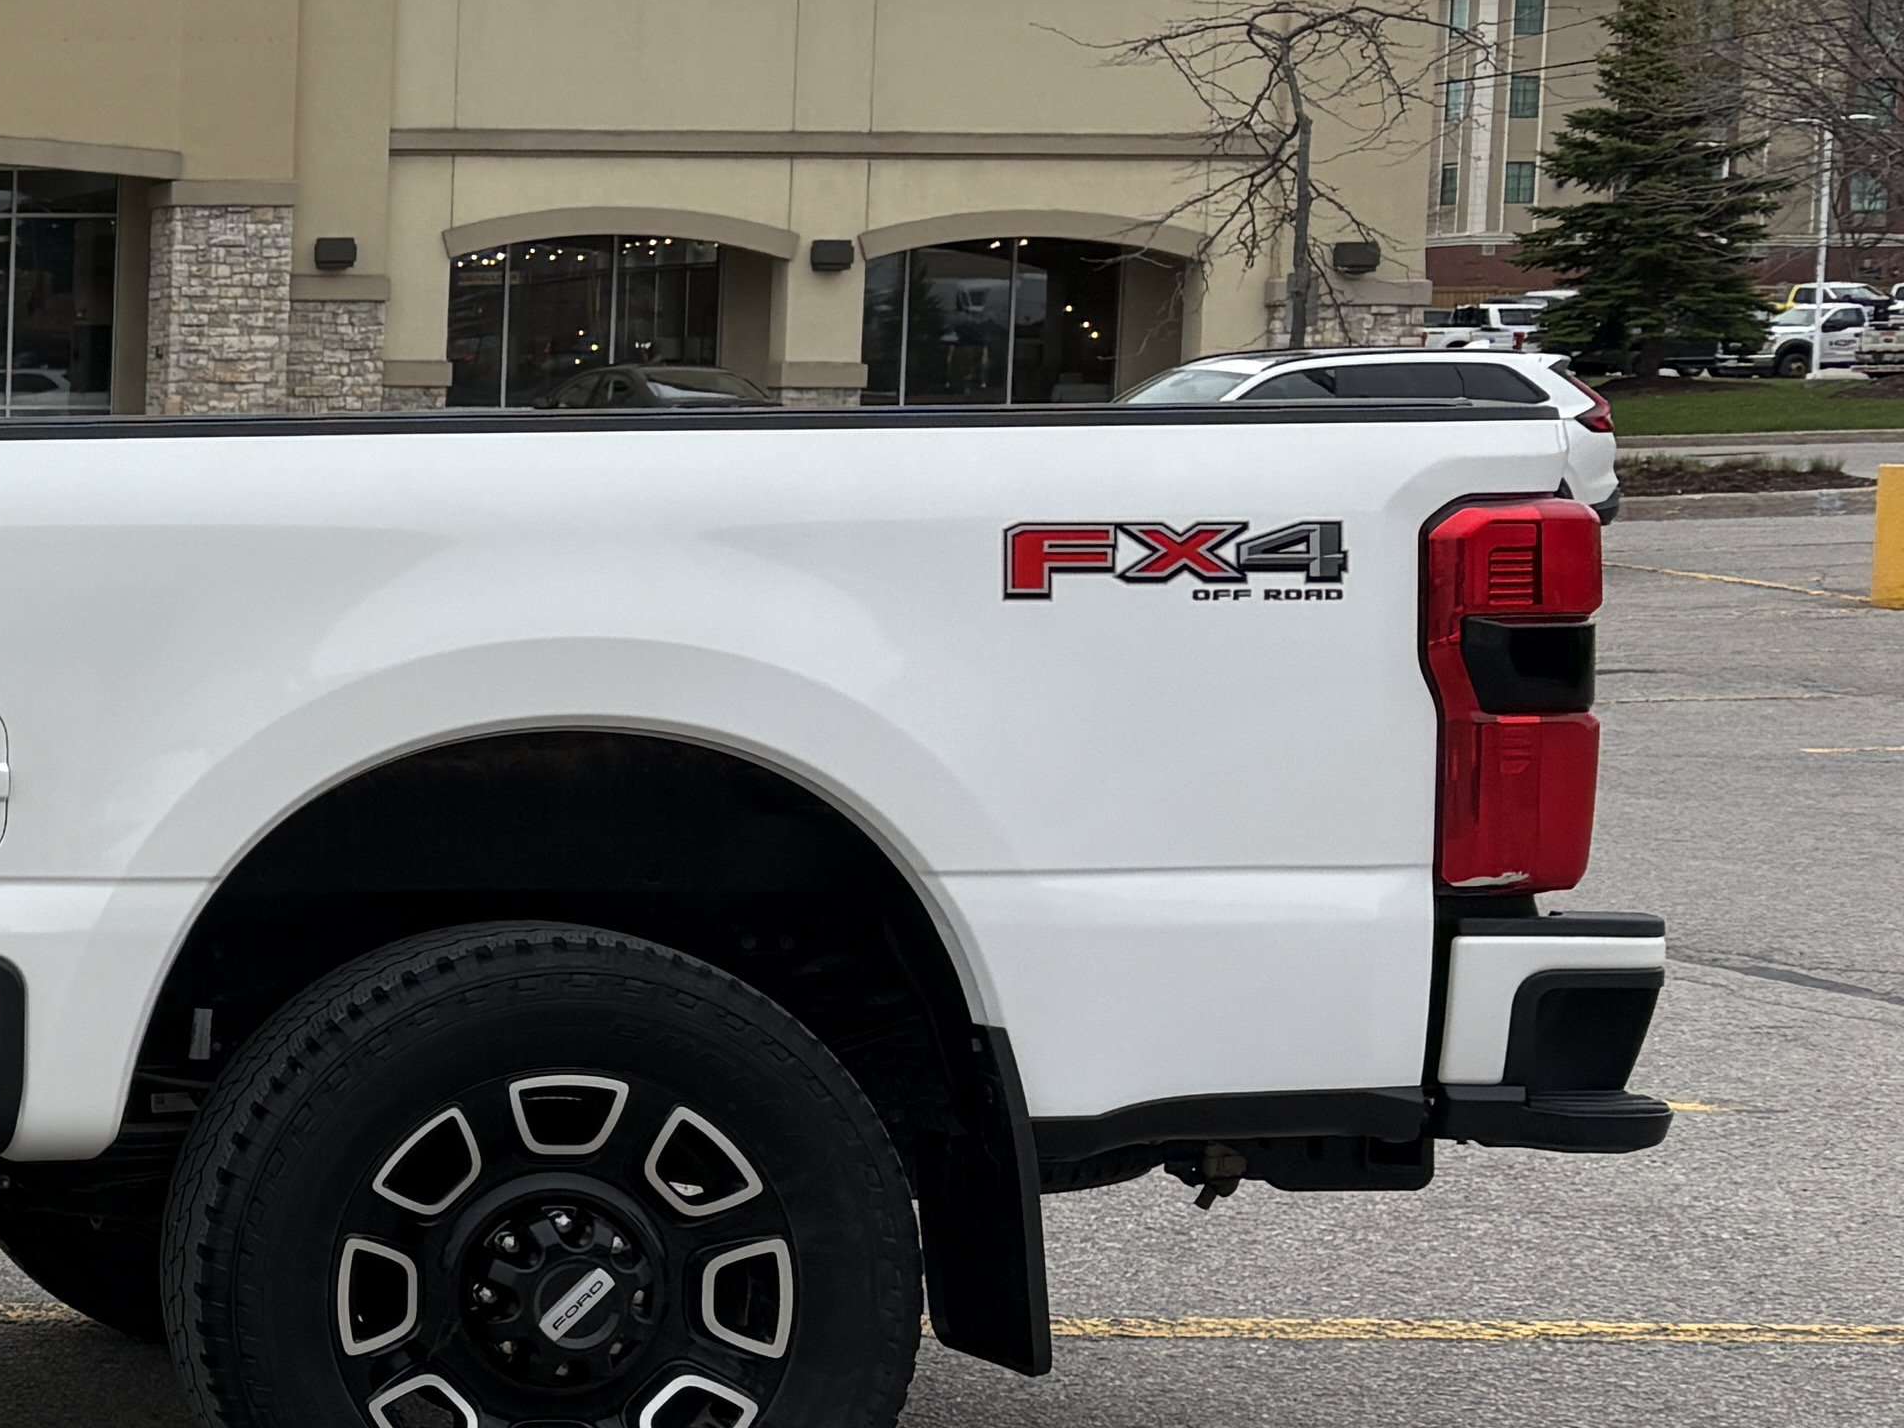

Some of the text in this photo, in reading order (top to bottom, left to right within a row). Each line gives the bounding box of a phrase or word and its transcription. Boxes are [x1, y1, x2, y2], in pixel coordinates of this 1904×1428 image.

[1003, 521, 1348, 600] FX4
[1192, 589, 1343, 601] OFF ROAD
[552, 1280, 604, 1330] FORD
